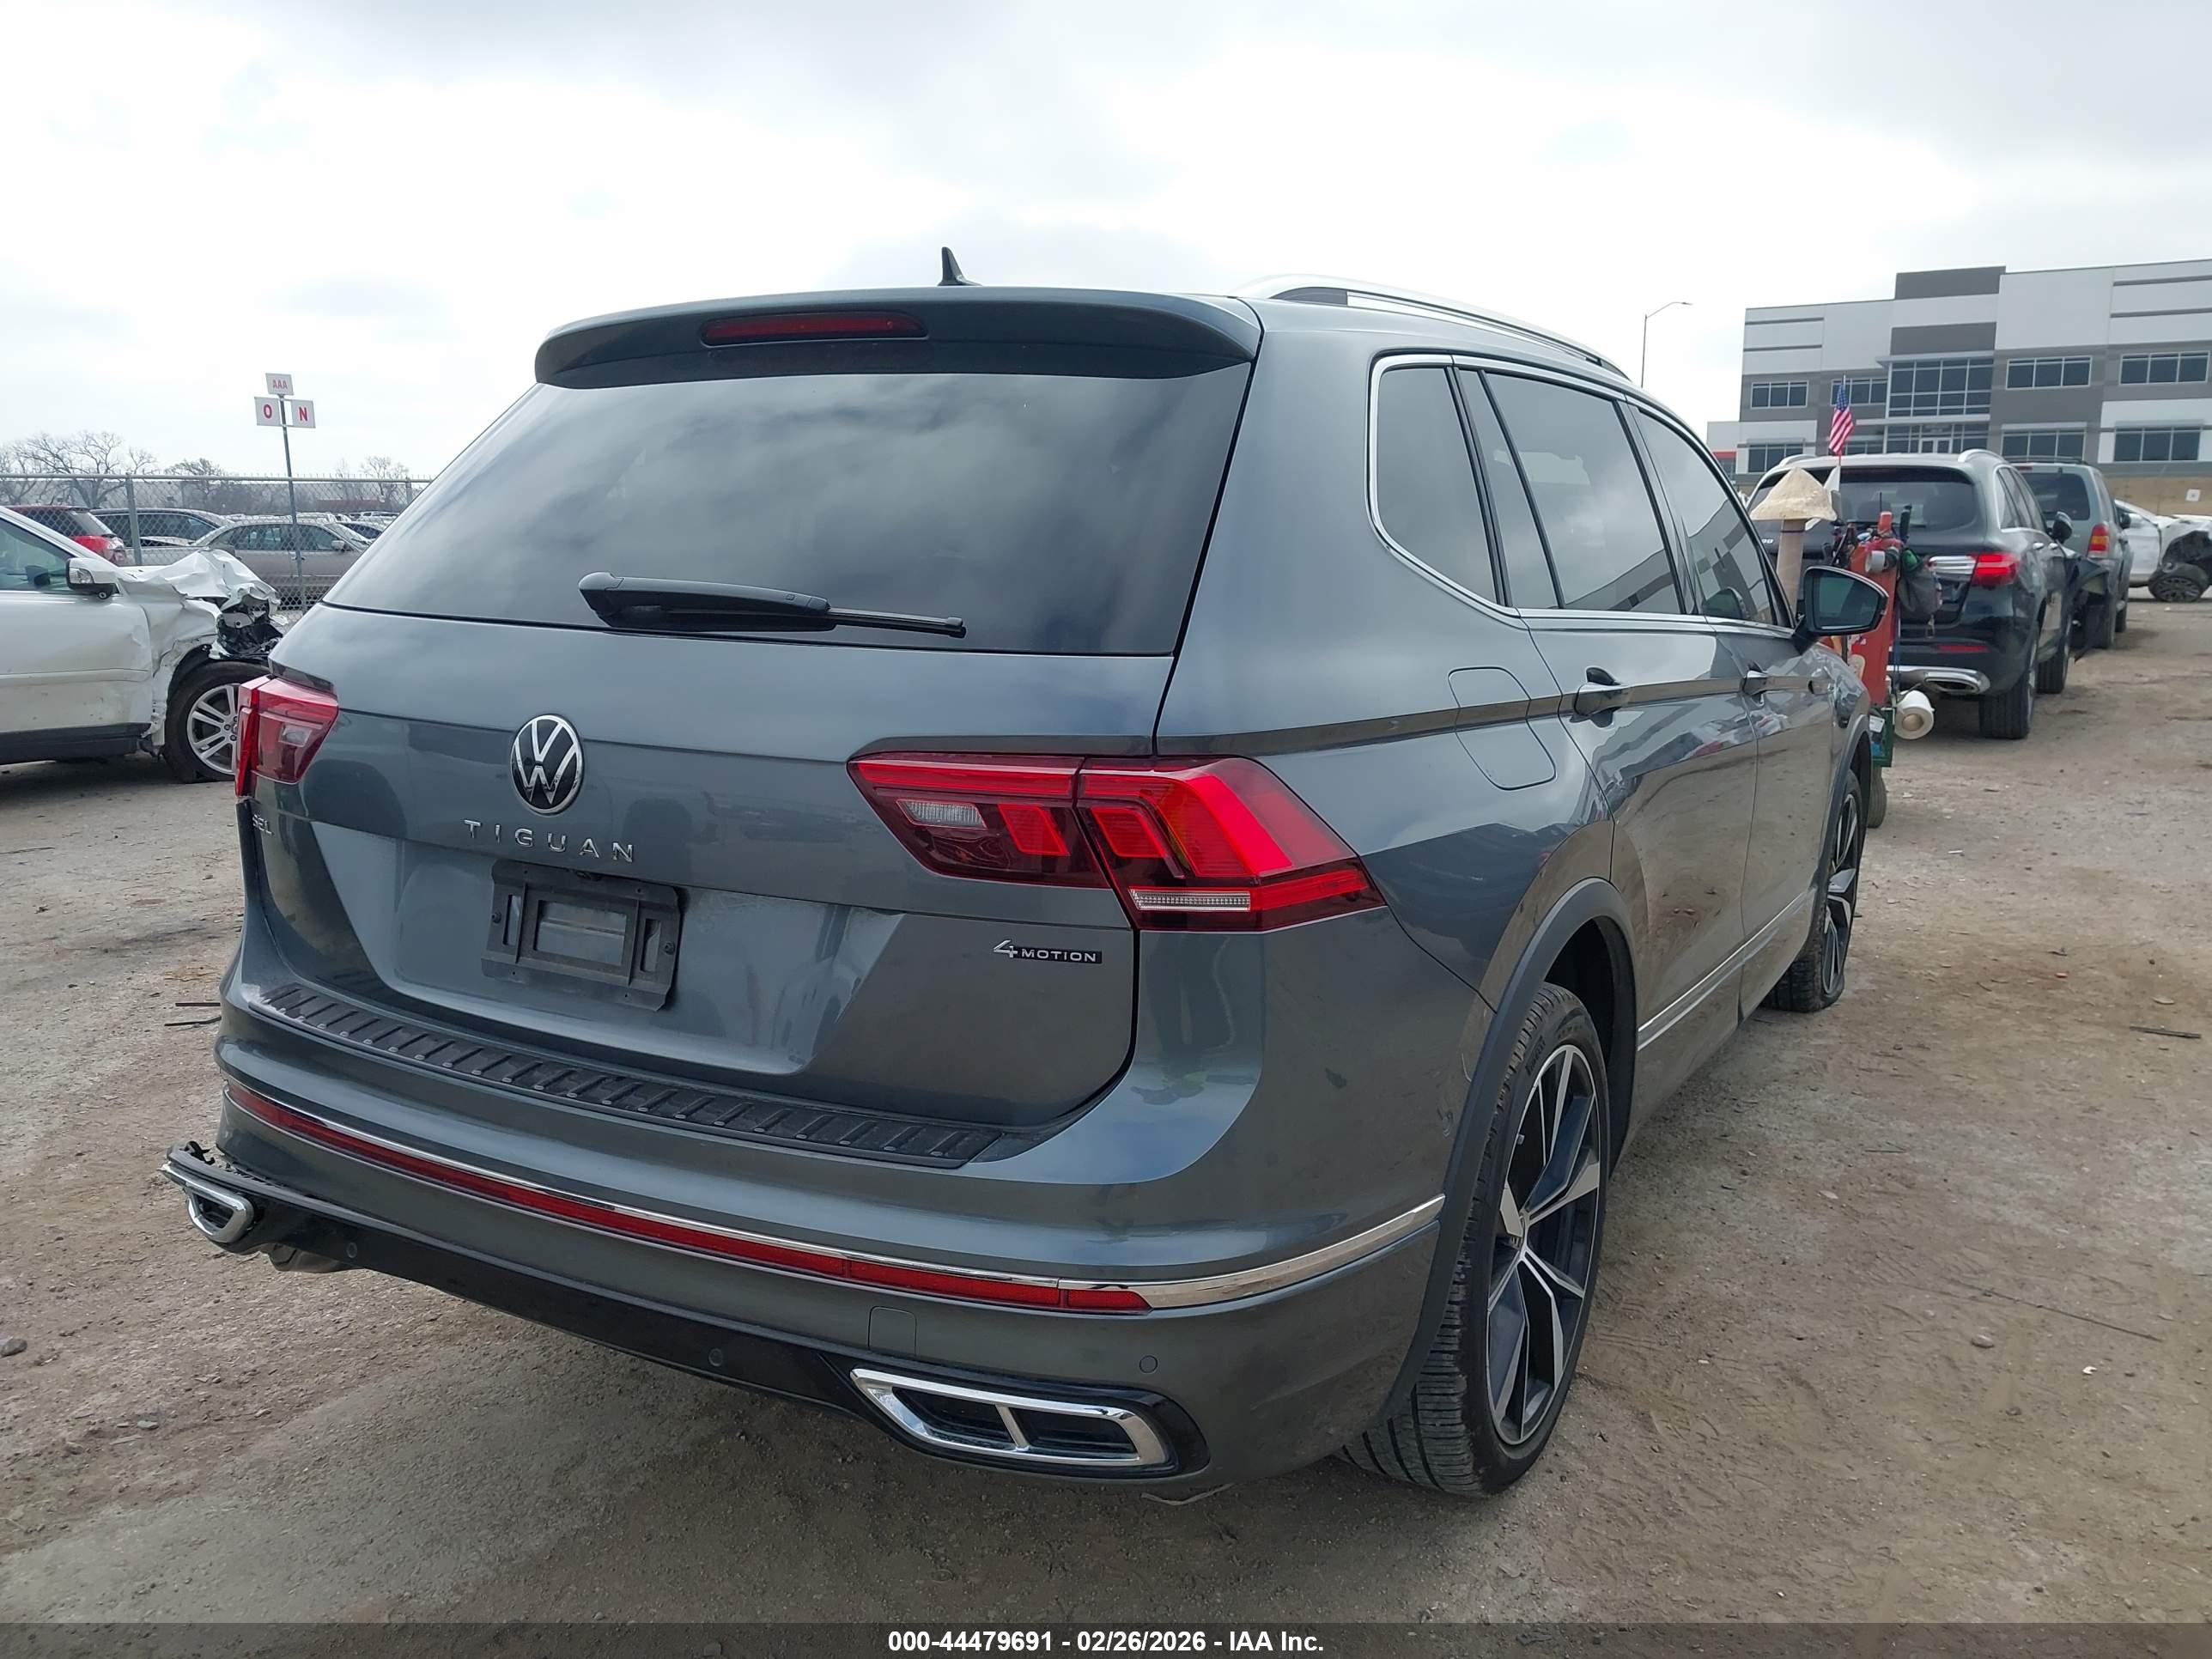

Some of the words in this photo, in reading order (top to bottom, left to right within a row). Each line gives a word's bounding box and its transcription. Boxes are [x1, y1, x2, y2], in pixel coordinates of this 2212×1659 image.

[272, 380, 288, 389] AAA
[298, 406, 308, 422] N
[464, 818, 634, 862] TIGUAN
[993, 939, 1097, 963] 4MOTION
